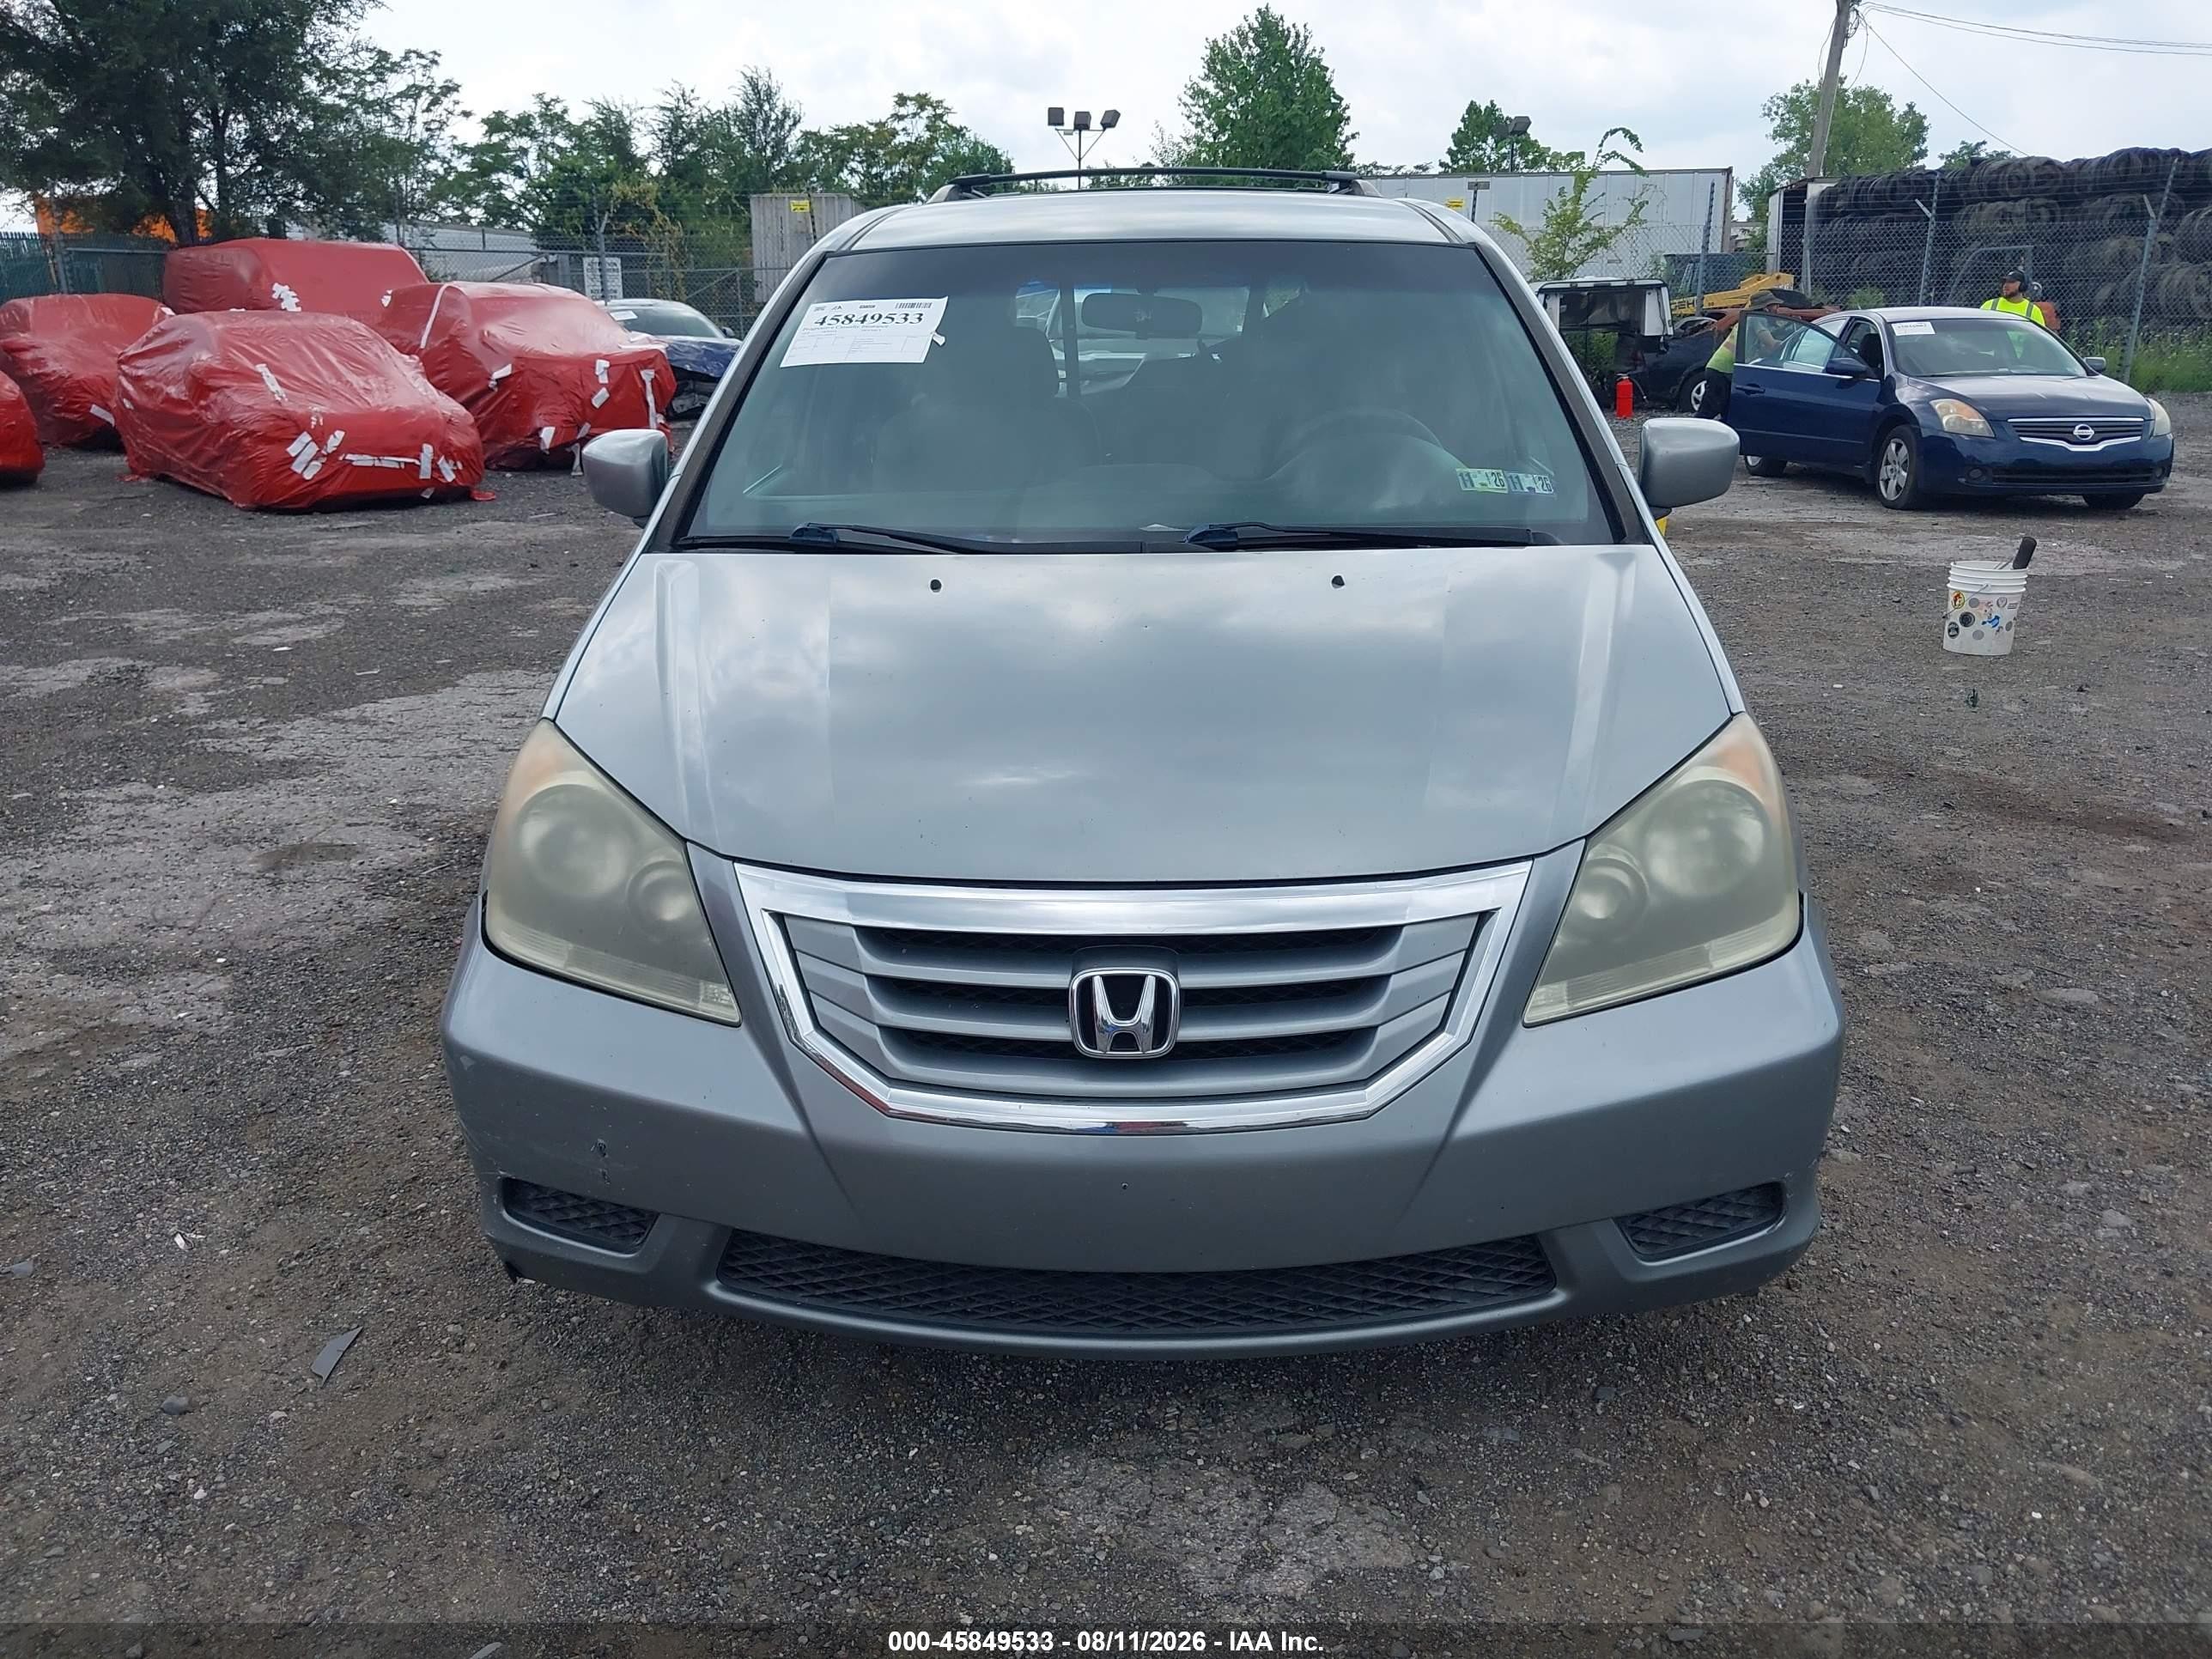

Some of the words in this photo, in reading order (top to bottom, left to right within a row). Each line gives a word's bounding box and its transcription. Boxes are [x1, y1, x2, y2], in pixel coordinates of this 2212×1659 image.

[815, 313, 924, 325] 45849533
[1491, 471, 1505, 488] 26
[1537, 476, 1553, 492] 26
